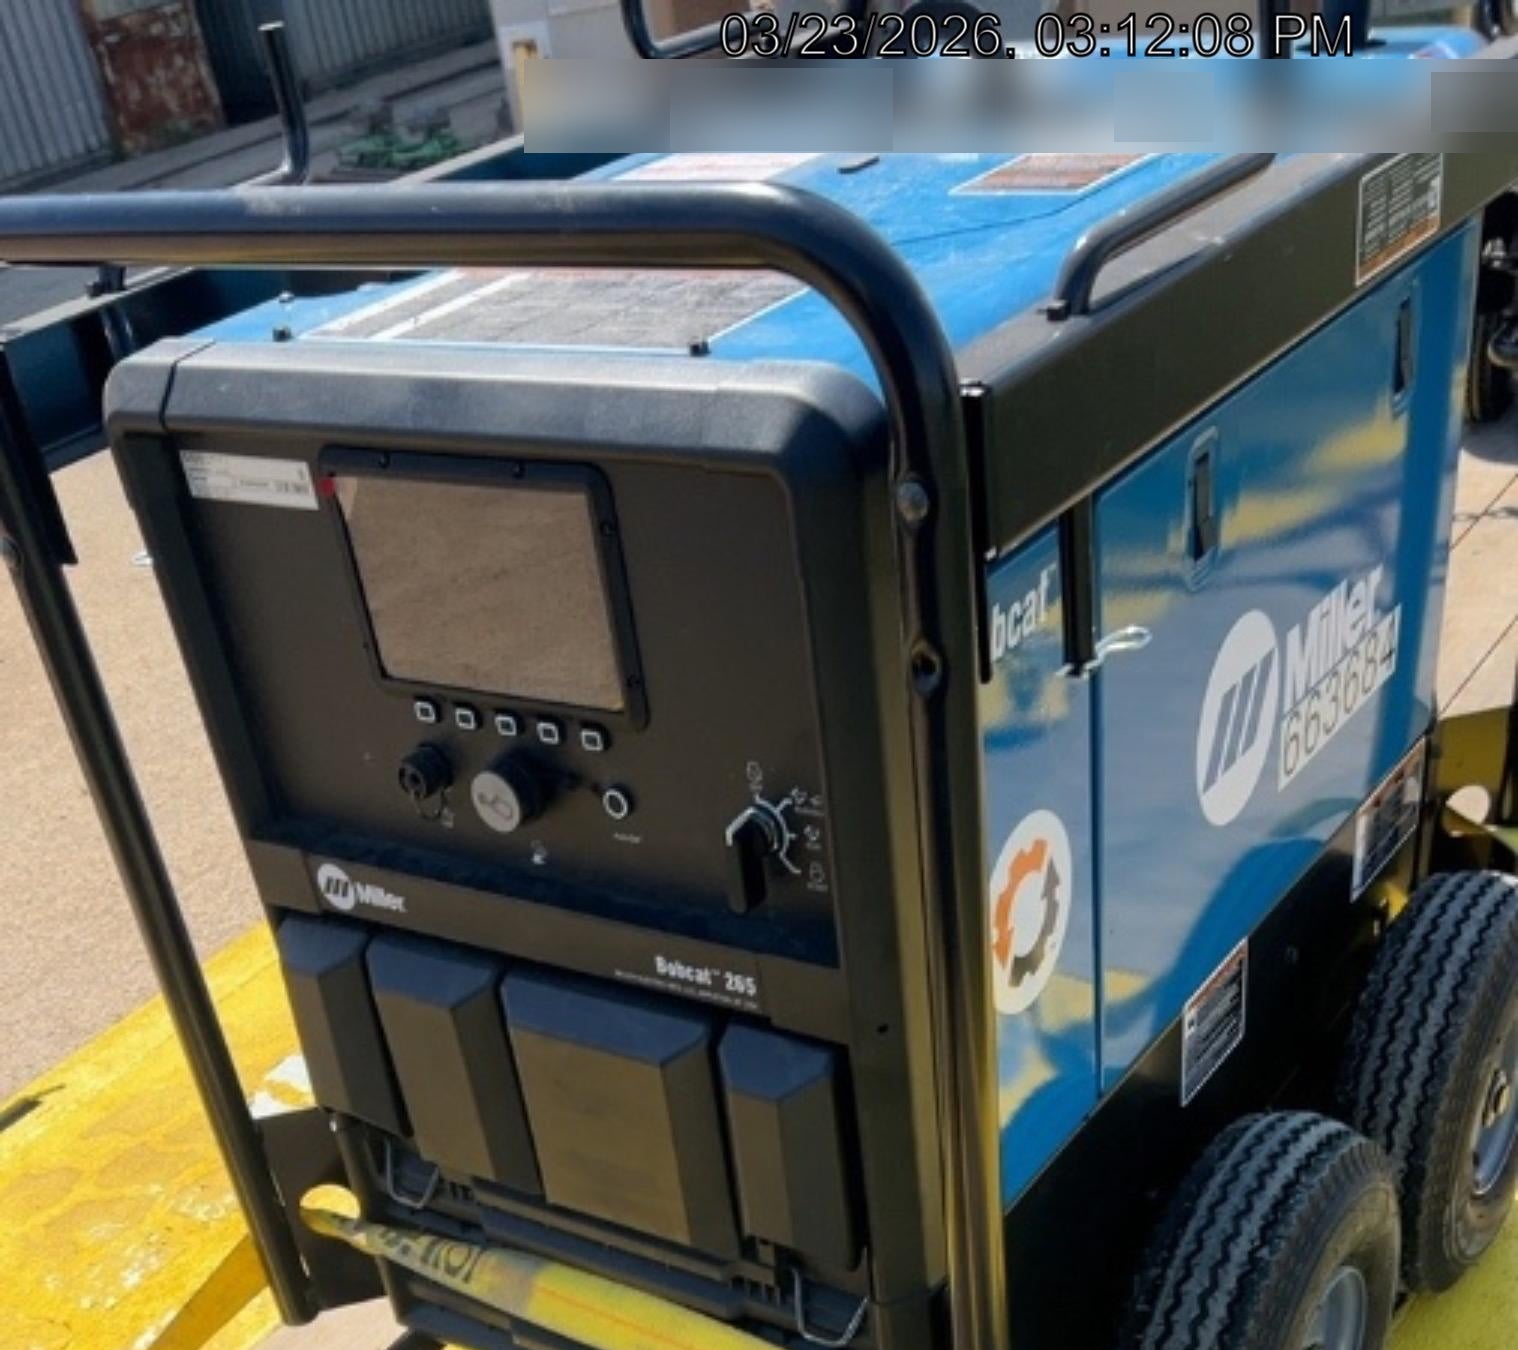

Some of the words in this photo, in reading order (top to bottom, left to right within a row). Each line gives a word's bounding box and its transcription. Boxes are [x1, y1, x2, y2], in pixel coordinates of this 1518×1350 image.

[990, 569, 1049, 662] bcat
[1284, 563, 1383, 717] Miller
[1283, 610, 1397, 776] 663684
[354, 881, 408, 913] Miller
